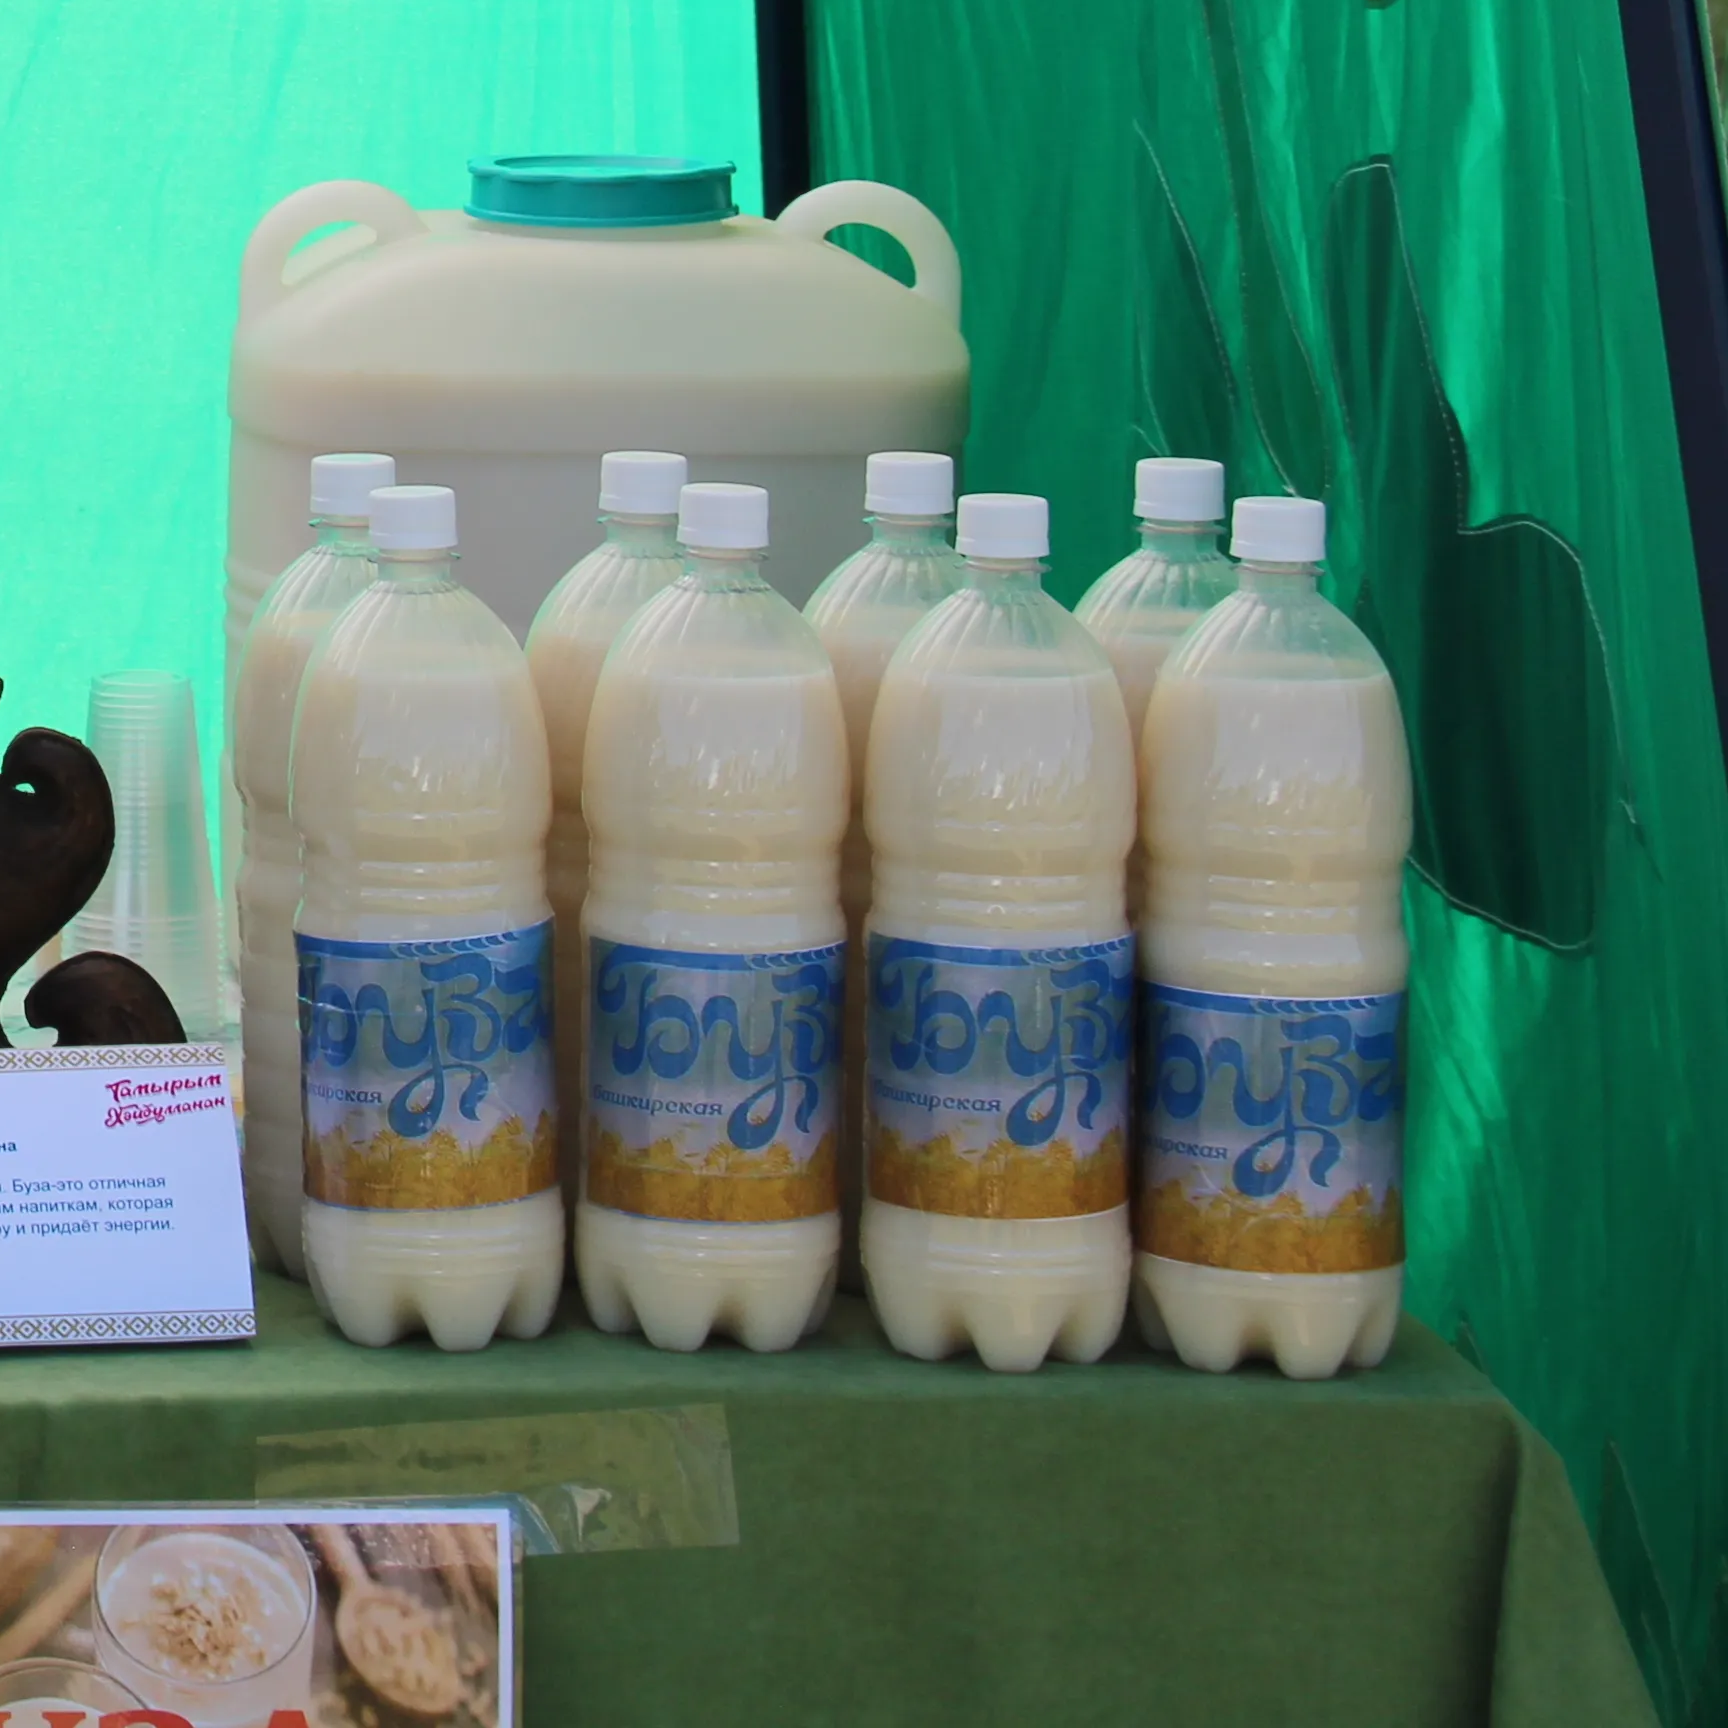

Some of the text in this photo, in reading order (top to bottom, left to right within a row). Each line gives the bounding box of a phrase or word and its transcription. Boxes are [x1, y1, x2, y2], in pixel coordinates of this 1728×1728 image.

[105, 1073, 221, 1103] Тамырым
[593, 1084, 723, 1116] башкирская
[12, 1178, 84, 1195] Буза-это
[89, 1175, 166, 1191] отличная
[20, 1199, 103, 1216] напиткам,
[109, 1197, 174, 1212] которая
[16, 1223, 26, 1235] и
[31, 1219, 99, 1238] придаёт
[105, 1219, 175, 1235] энергии.
